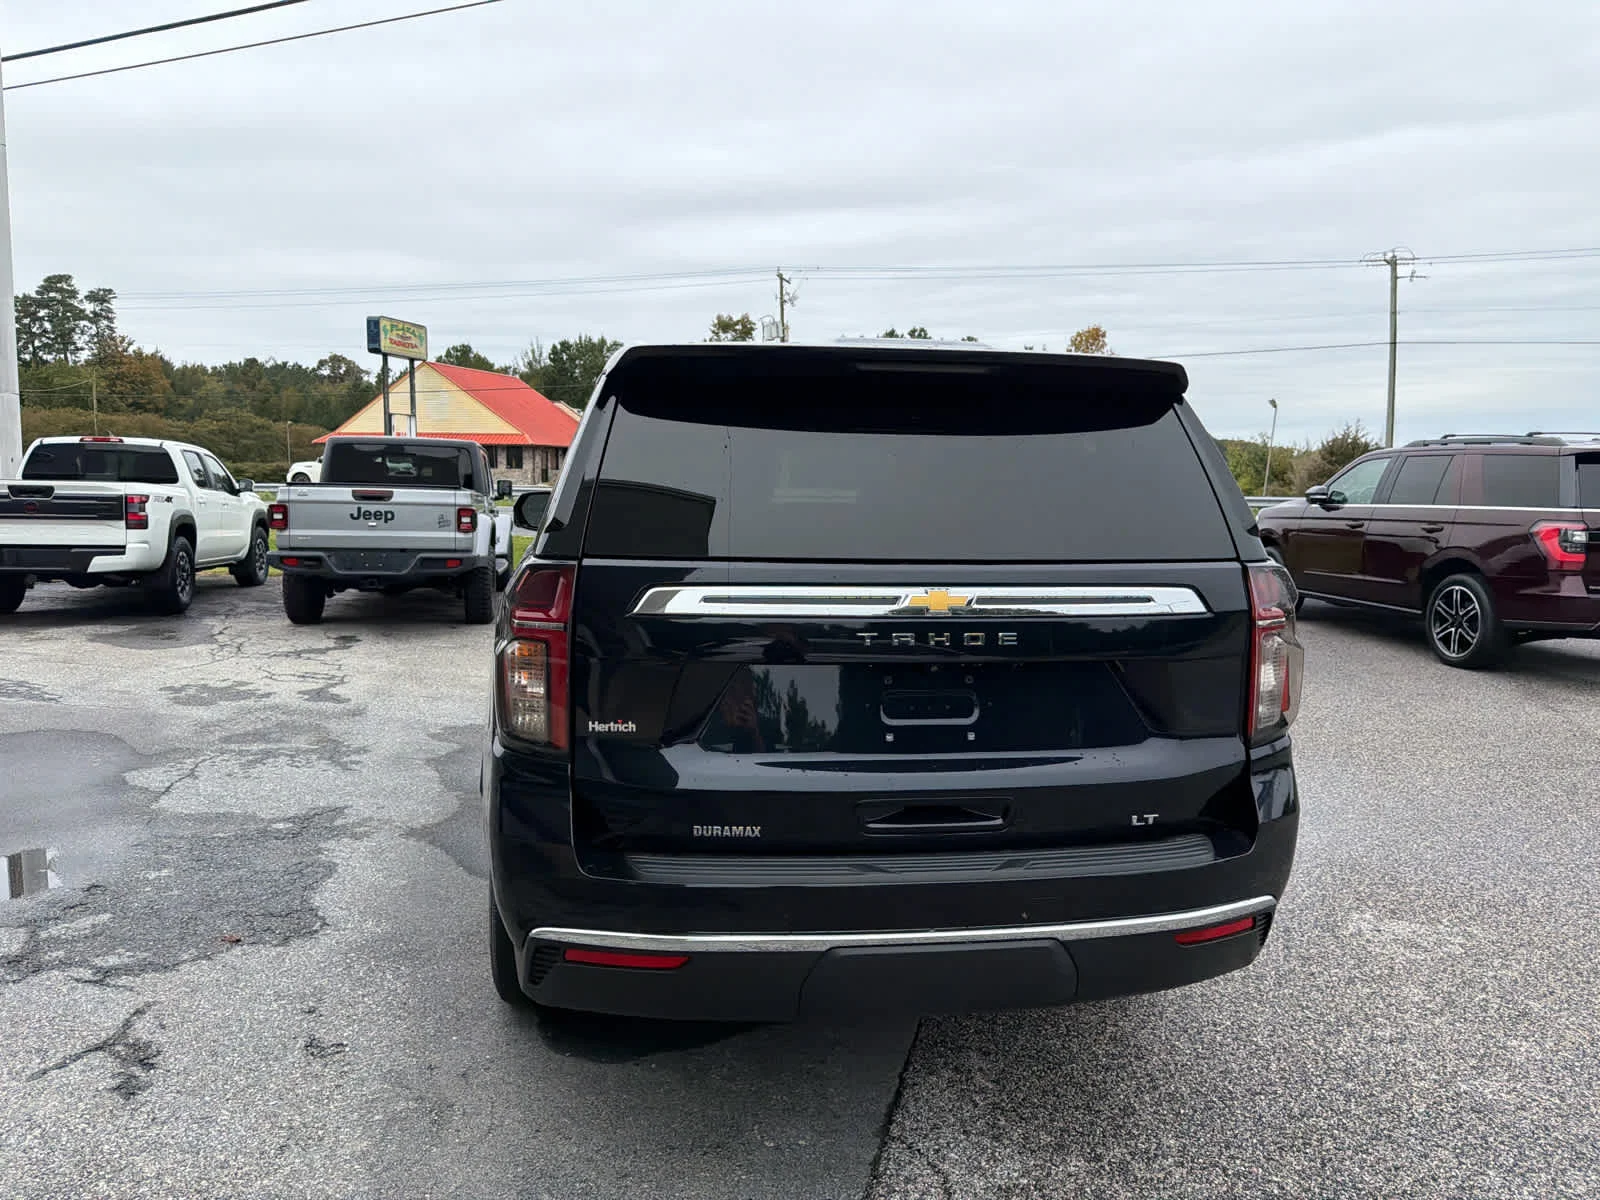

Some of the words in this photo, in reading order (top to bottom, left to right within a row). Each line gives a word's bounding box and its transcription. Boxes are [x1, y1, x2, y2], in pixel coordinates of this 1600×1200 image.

[349, 506, 395, 523] Jeep
[856, 632, 1018, 646] TAHOE
[588, 719, 637, 732] Hertrich
[1131, 814, 1160, 826] LT
[692, 825, 761, 838] DURAMAX
